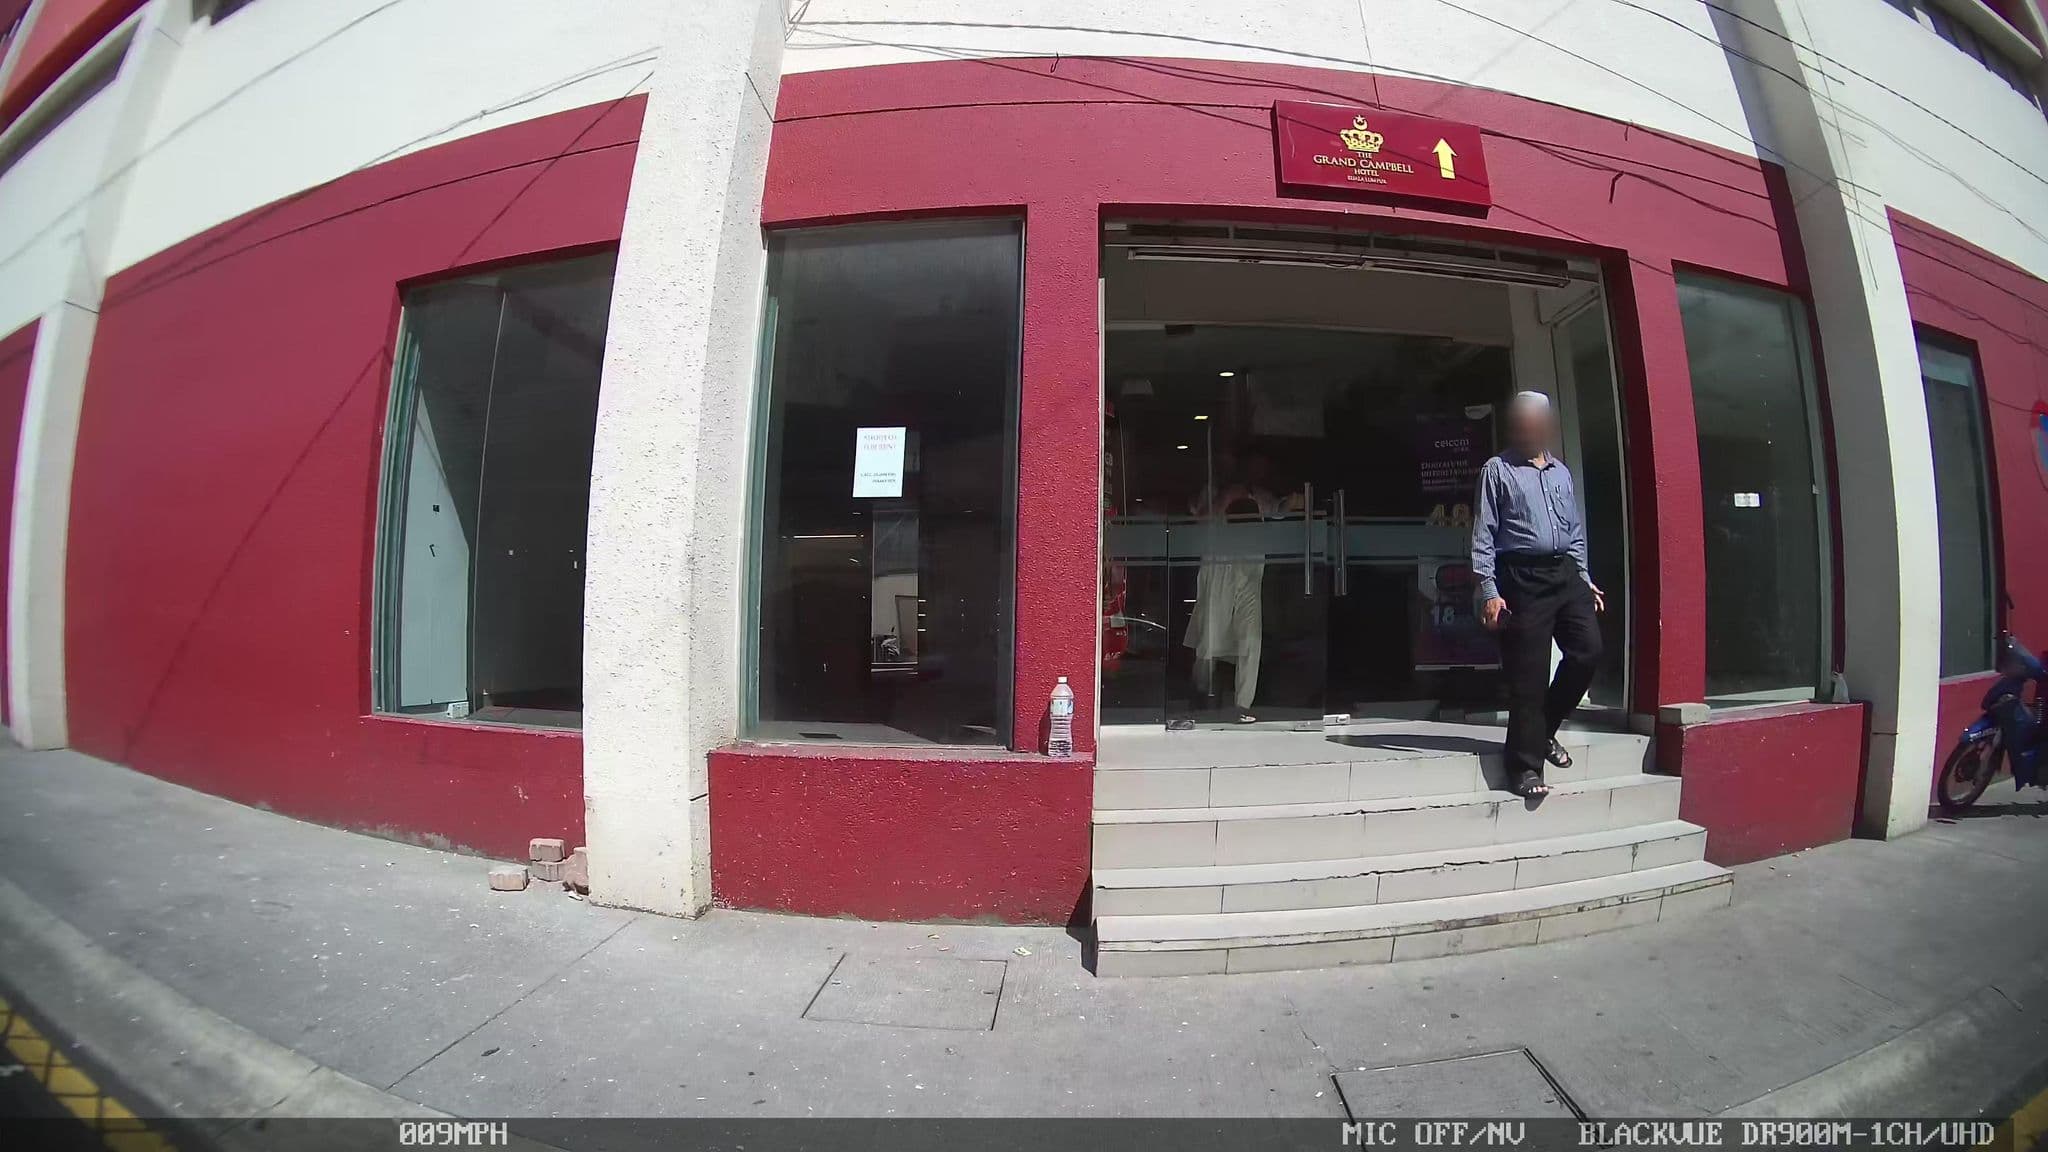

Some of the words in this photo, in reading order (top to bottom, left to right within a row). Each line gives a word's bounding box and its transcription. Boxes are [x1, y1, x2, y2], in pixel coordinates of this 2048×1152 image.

[1313, 154, 1357, 167] GRAND
[1360, 159, 1414, 174] CAMPBELL
[1354, 168, 1380, 177] HOTEL
[1434, 439, 1470, 449] celcom
